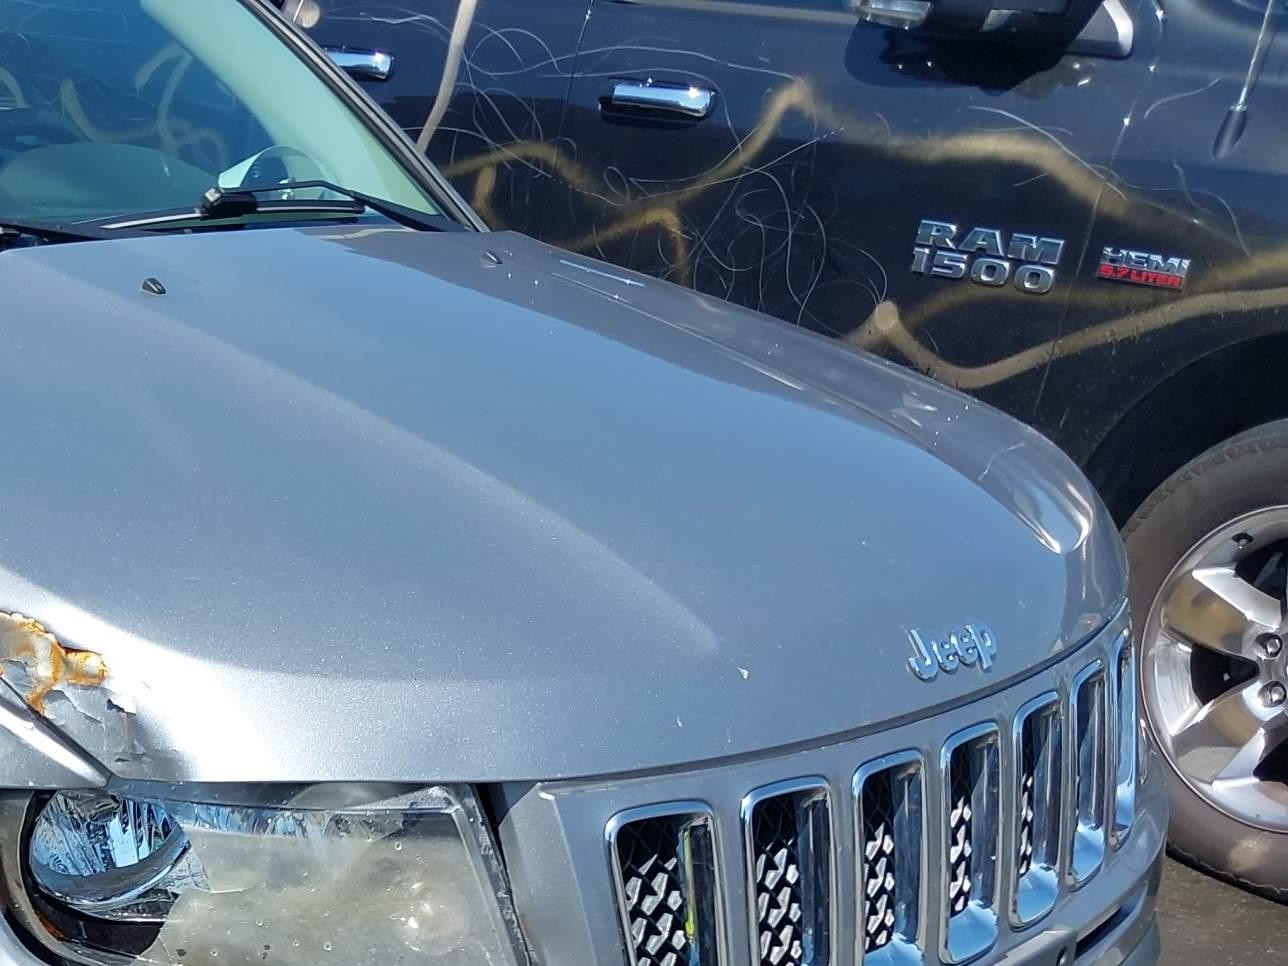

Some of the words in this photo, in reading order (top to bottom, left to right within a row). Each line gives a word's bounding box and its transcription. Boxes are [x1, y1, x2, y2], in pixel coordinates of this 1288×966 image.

[915, 218, 1066, 265] RAM
[1100, 246, 1192, 274] HEMI
[911, 246, 1056, 294] 1500
[1098, 263, 1129, 279] 5.7
[1130, 269, 1182, 289] LITER
[906, 623, 997, 683] Jeep
